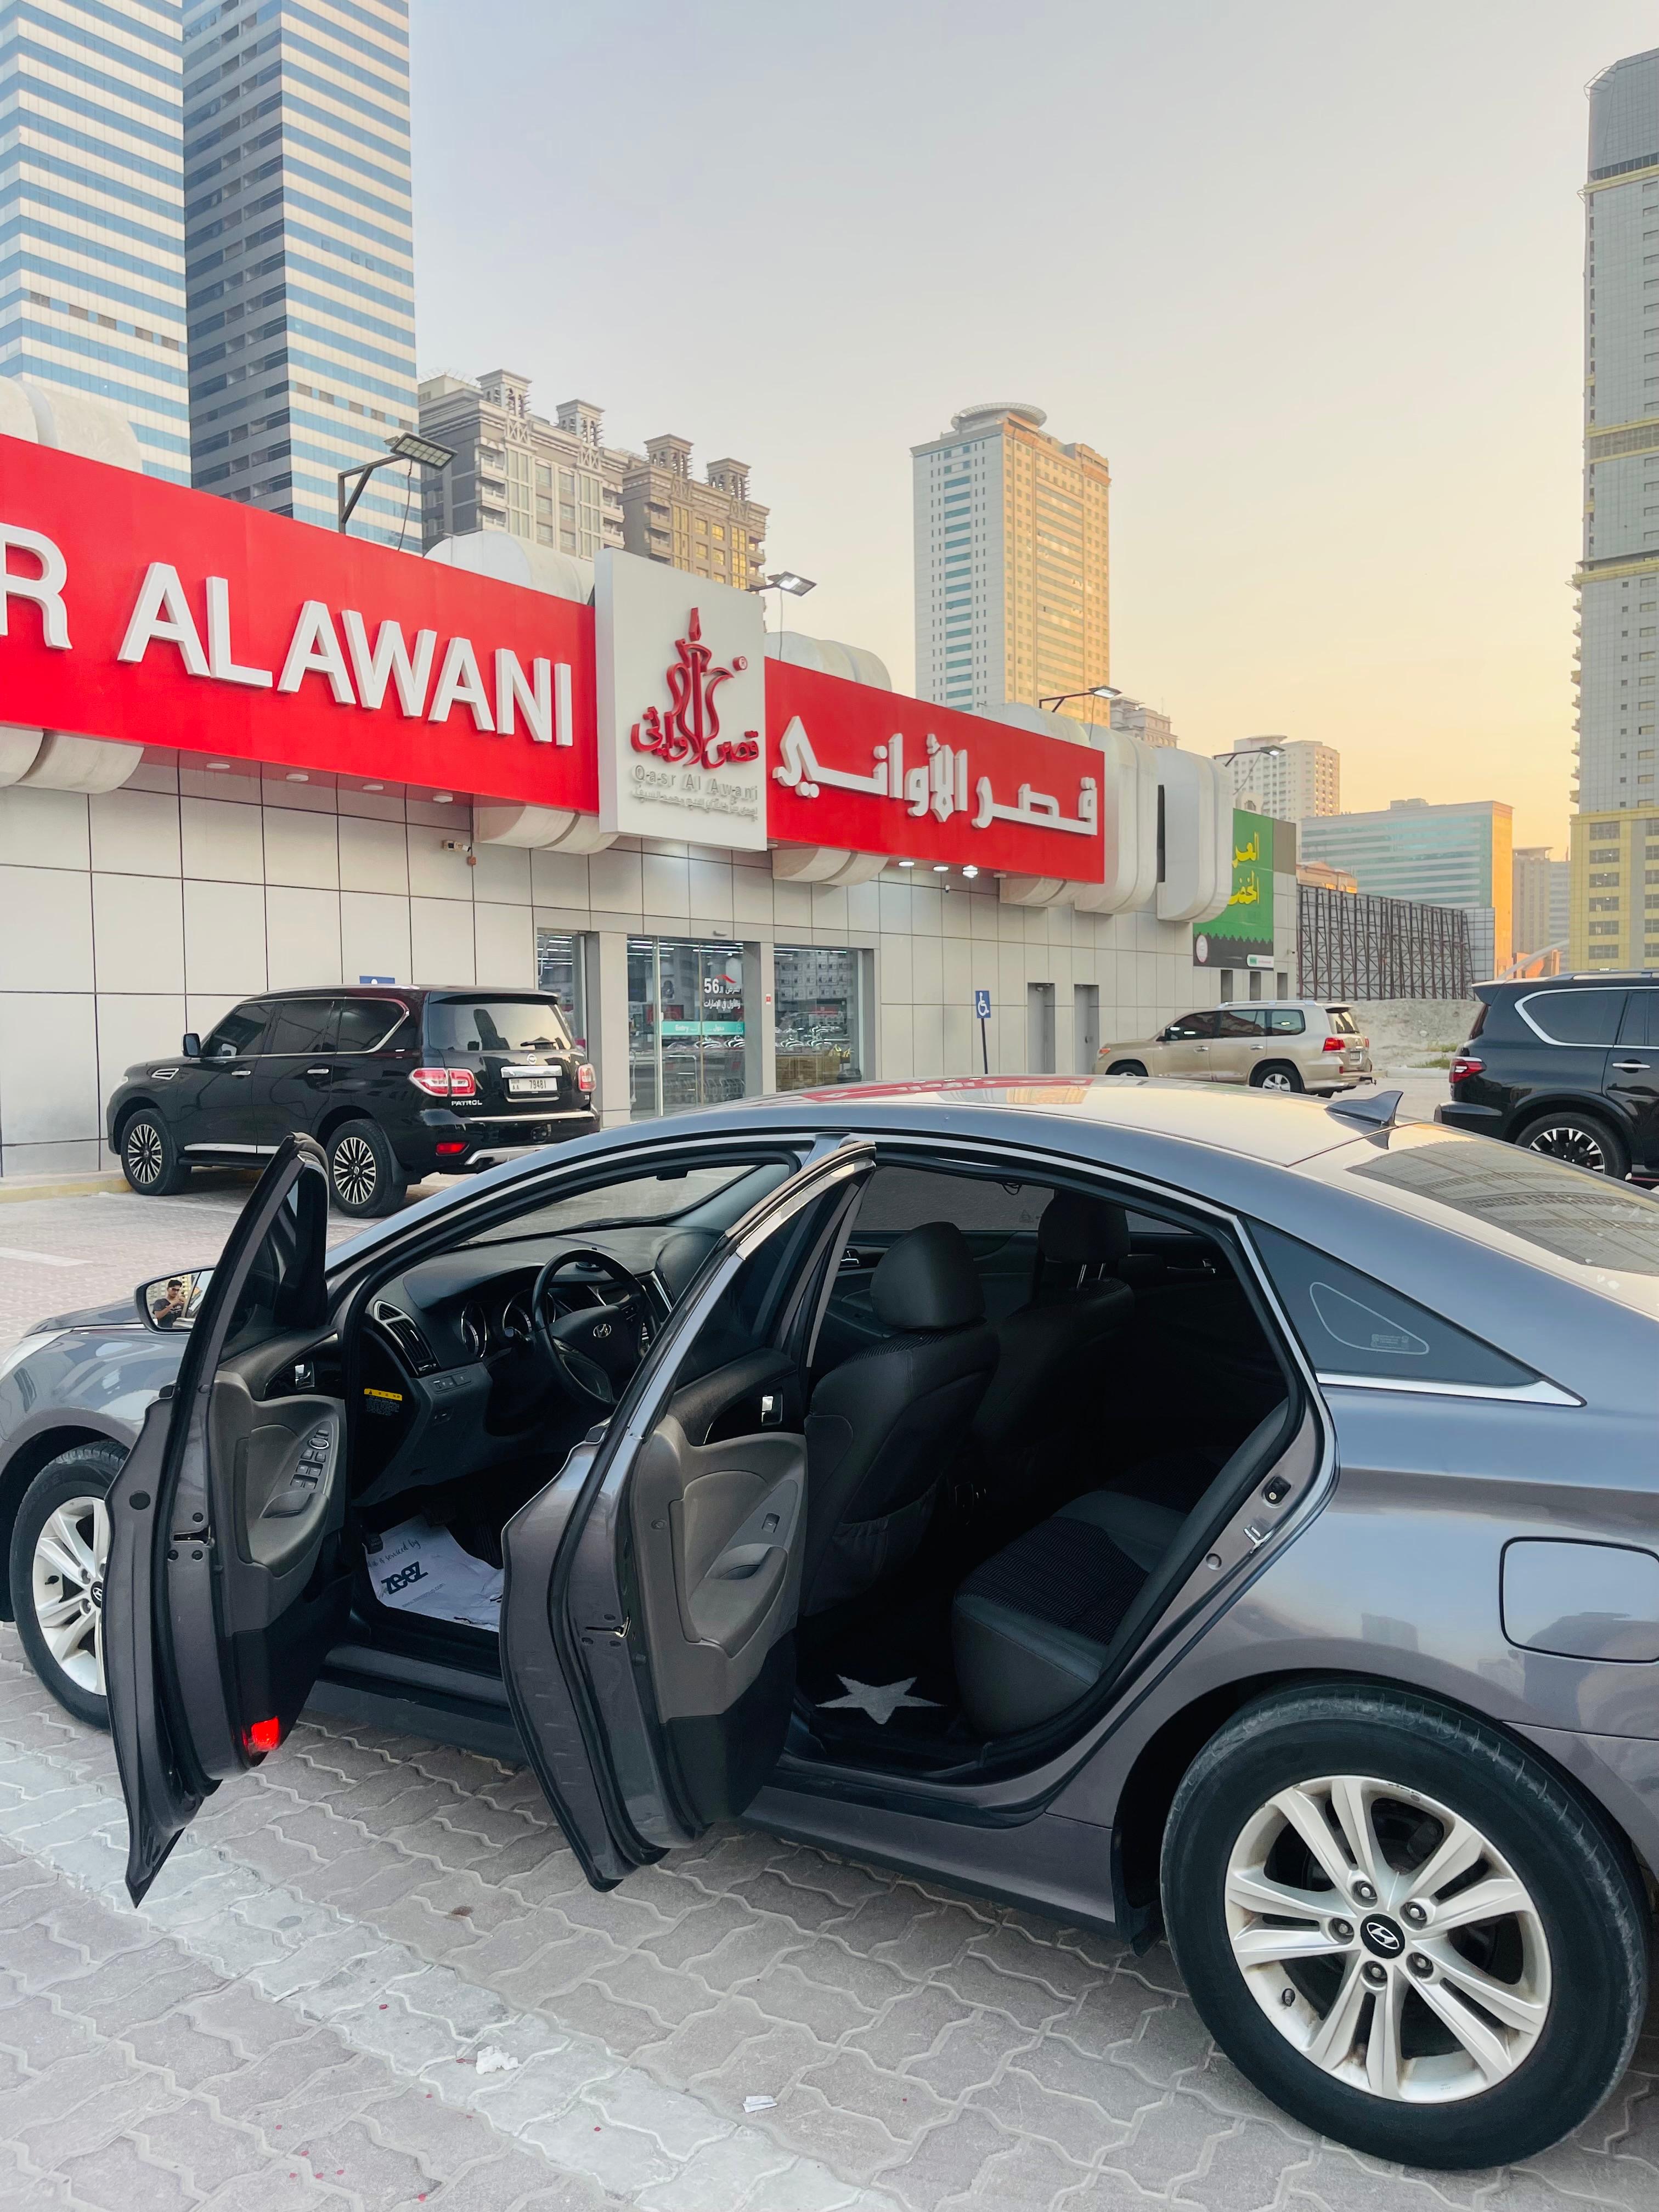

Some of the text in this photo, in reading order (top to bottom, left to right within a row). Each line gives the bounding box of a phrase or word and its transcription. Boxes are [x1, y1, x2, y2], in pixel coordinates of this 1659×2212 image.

[0, 523, 72, 650] R
[633, 765, 758, 800] Qasr Al Awani
[772, 715, 1097, 836] قصر الأواني
[704, 978, 719, 994] 56
[529, 1079, 546, 1090] 79481
[408, 1538, 421, 1550] by
[381, 1561, 428, 1594] zeez
